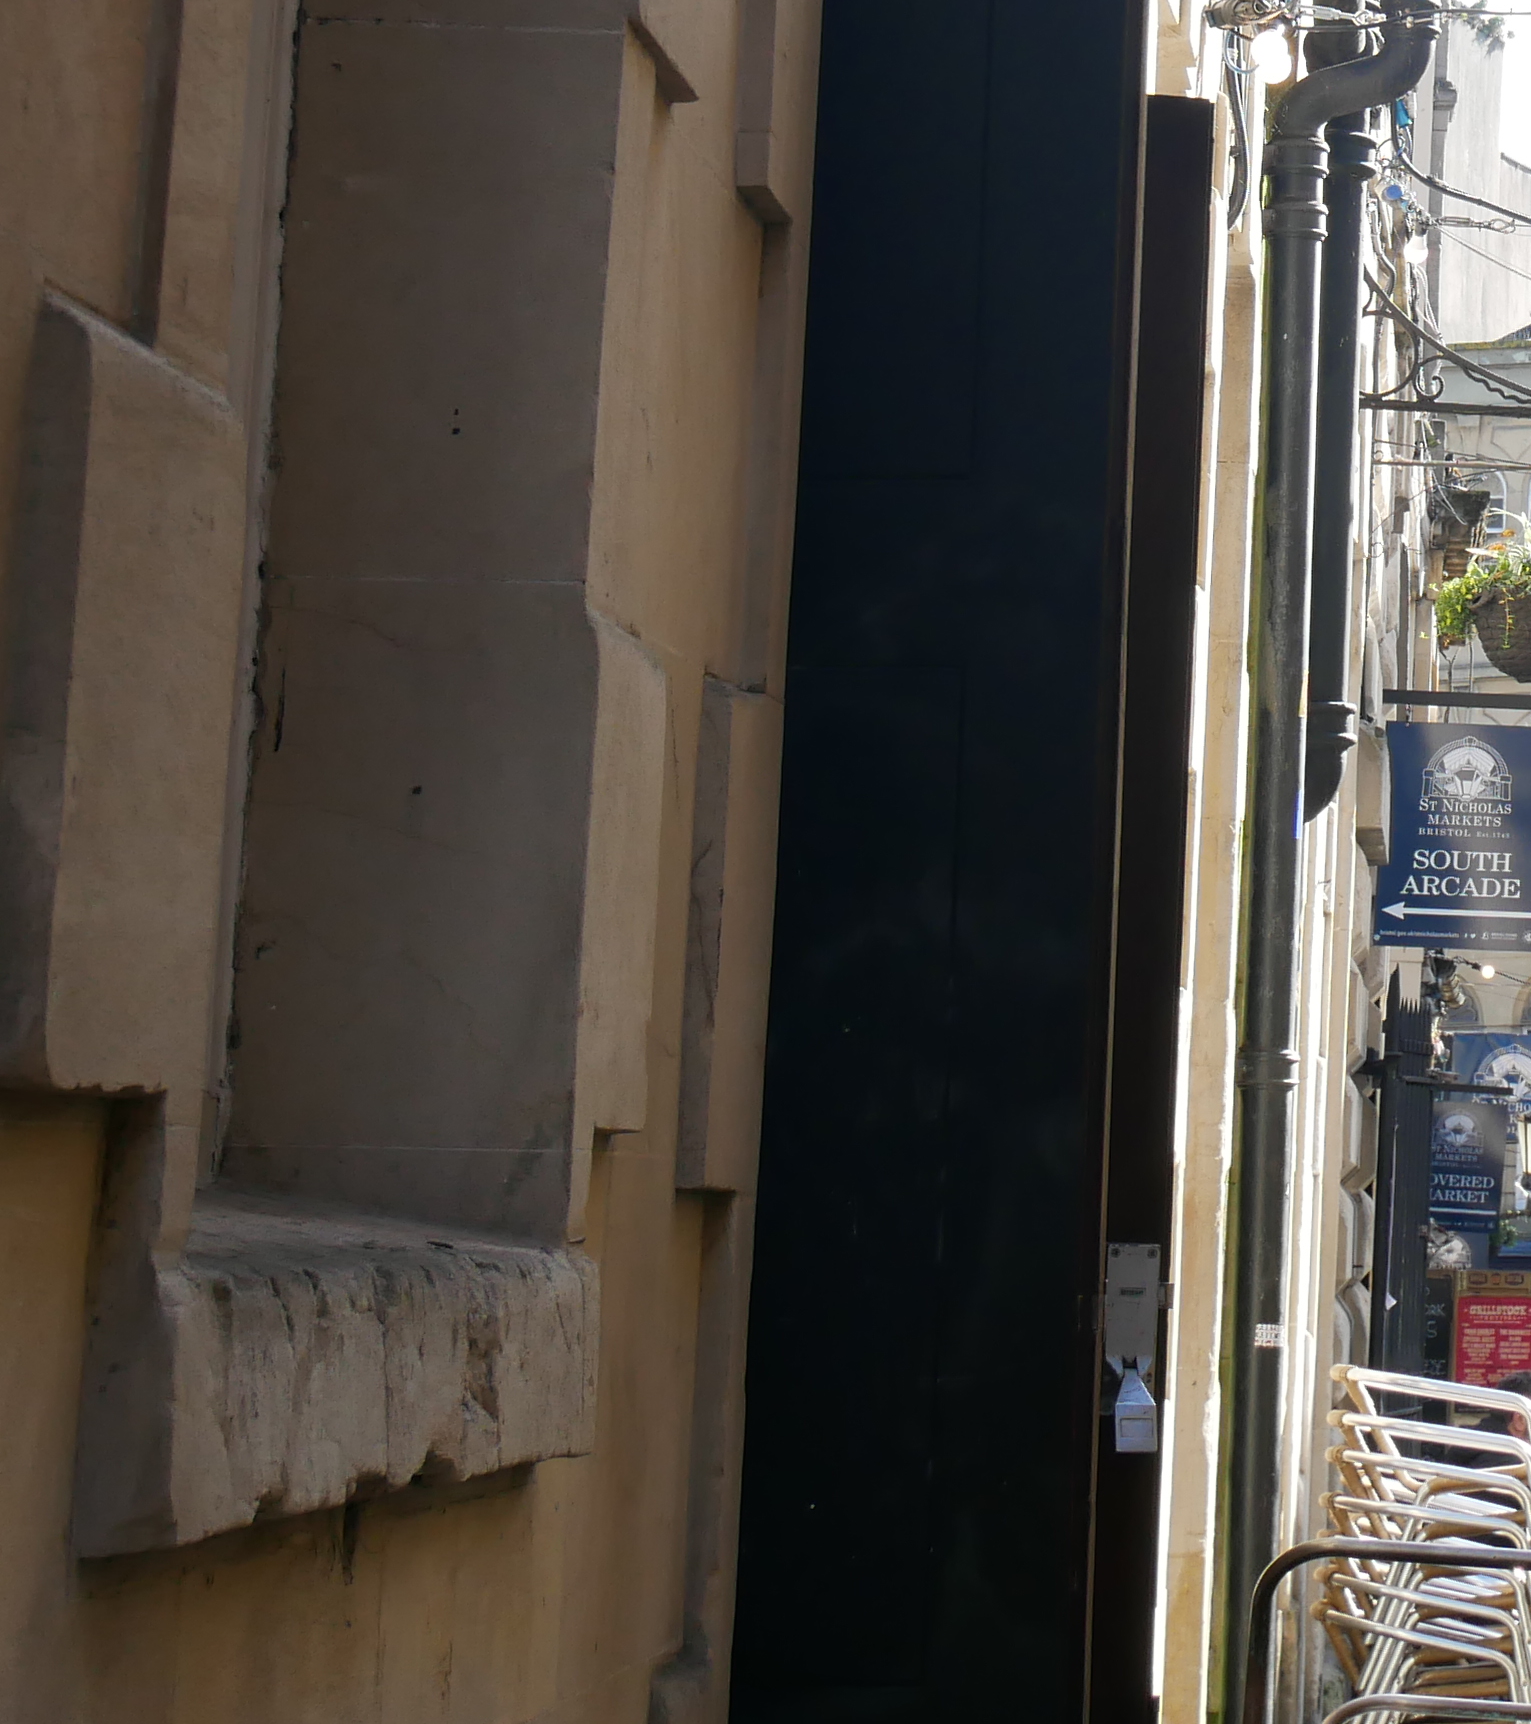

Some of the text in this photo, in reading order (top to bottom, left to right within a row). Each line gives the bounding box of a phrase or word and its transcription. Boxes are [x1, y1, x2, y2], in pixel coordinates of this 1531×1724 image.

[1418, 798, 1513, 815] ST NICHOLAS
[1427, 814, 1503, 828] MARKETS
[1417, 827, 1472, 838] BRISTOL
[1412, 848, 1513, 873] SOUTH
[1399, 874, 1521, 899] ARCADE
[1429, 1173, 1495, 1189] OVERED
